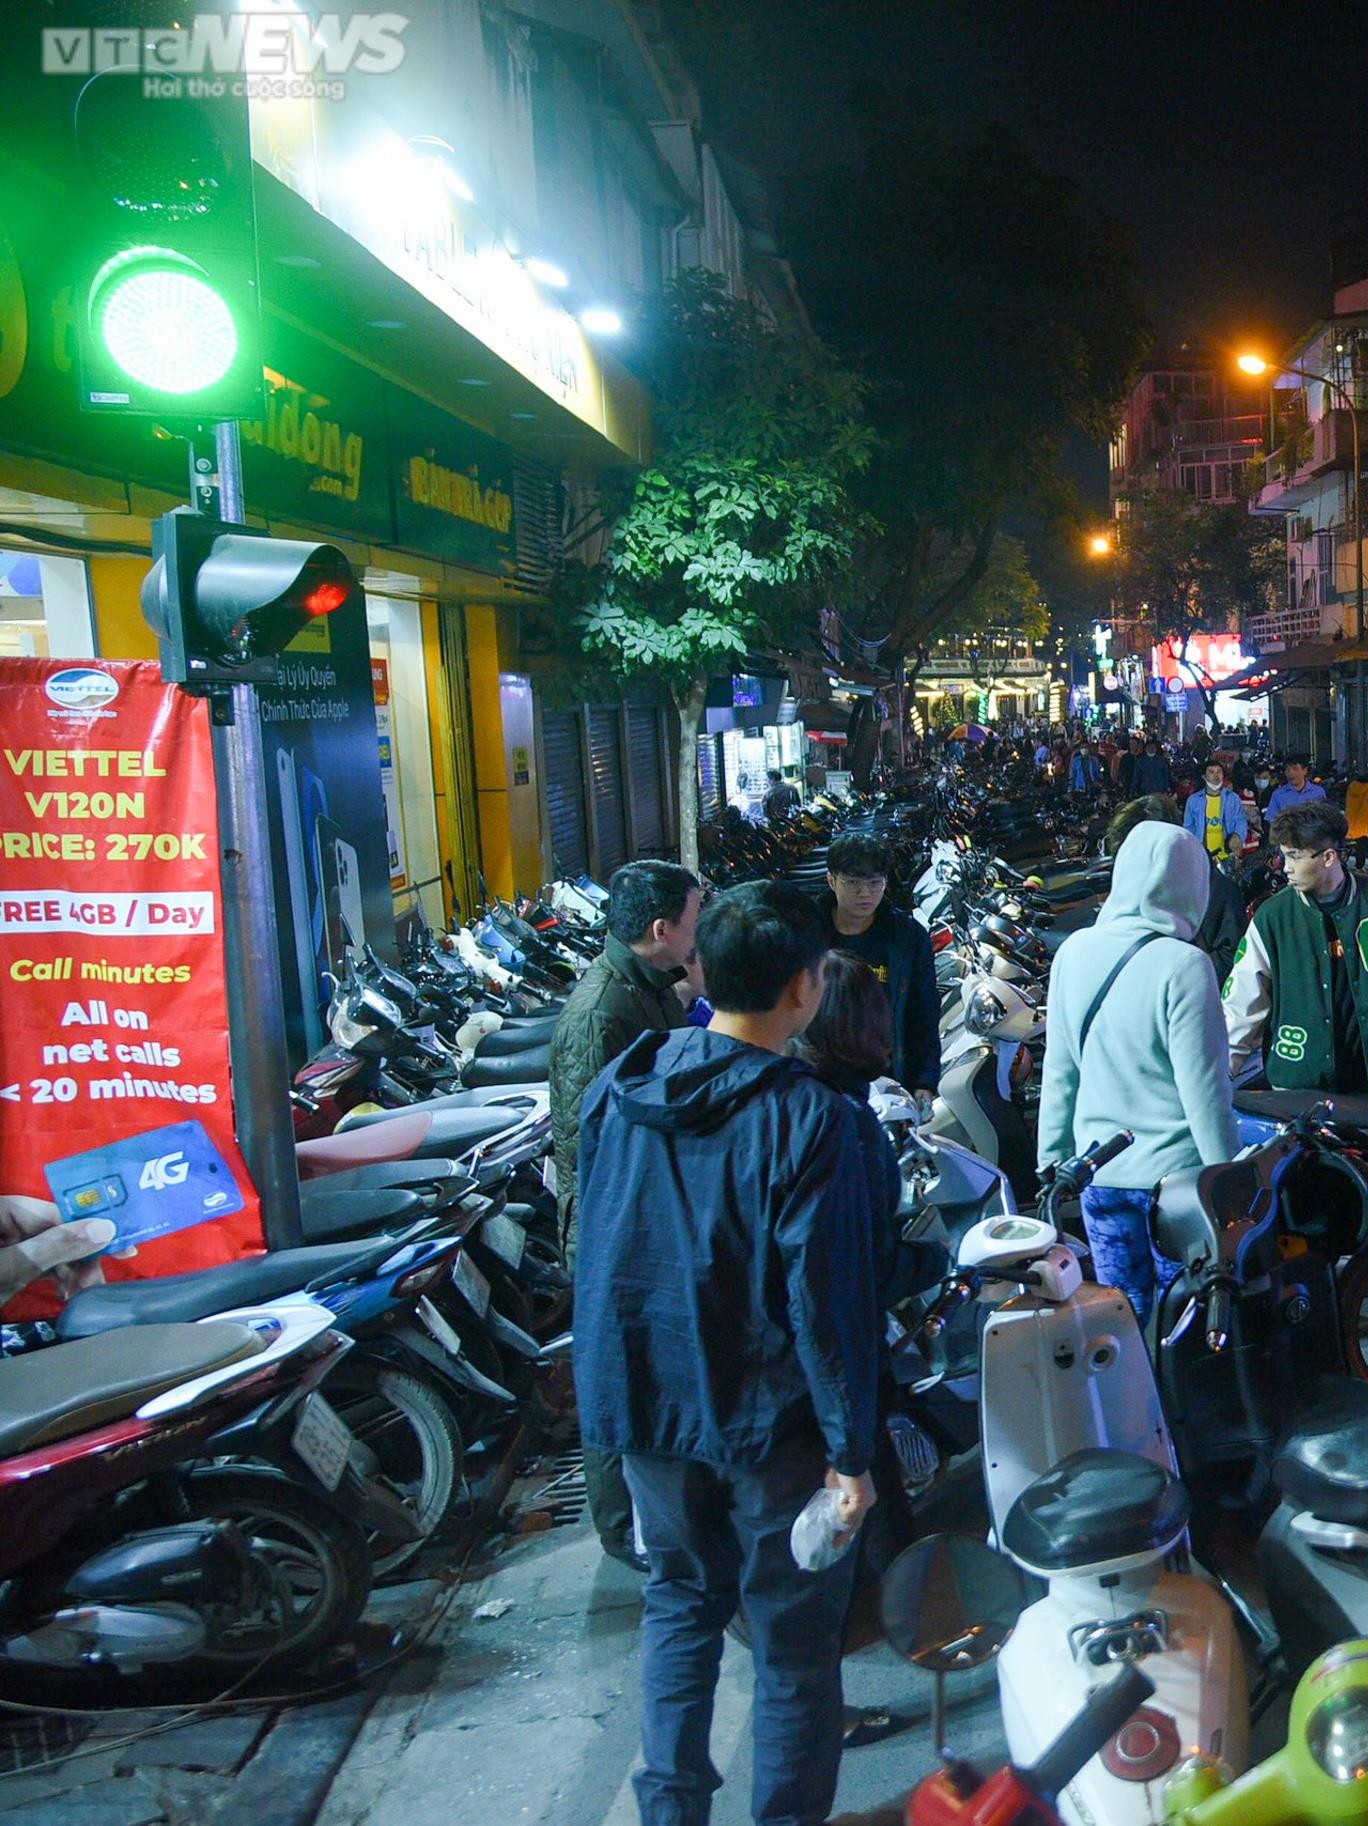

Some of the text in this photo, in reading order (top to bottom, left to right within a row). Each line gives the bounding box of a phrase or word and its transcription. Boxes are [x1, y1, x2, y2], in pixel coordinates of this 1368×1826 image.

[50, 685, 116, 693] VIETTEL
[5, 749, 168, 777] VIETTEL
[24, 791, 146, 819] V120N
[0, 831, 208, 861] RICE: 270K
[0, 899, 205, 930] REE 4GB / Day
[10, 957, 192, 984] Call minutes
[60, 999, 149, 1030] All on
[42, 1038, 182, 1068] net calls
[30, 1076, 78, 1104] 20
[89, 1070, 218, 1105] minutes
[138, 1150, 190, 1191] 4G
